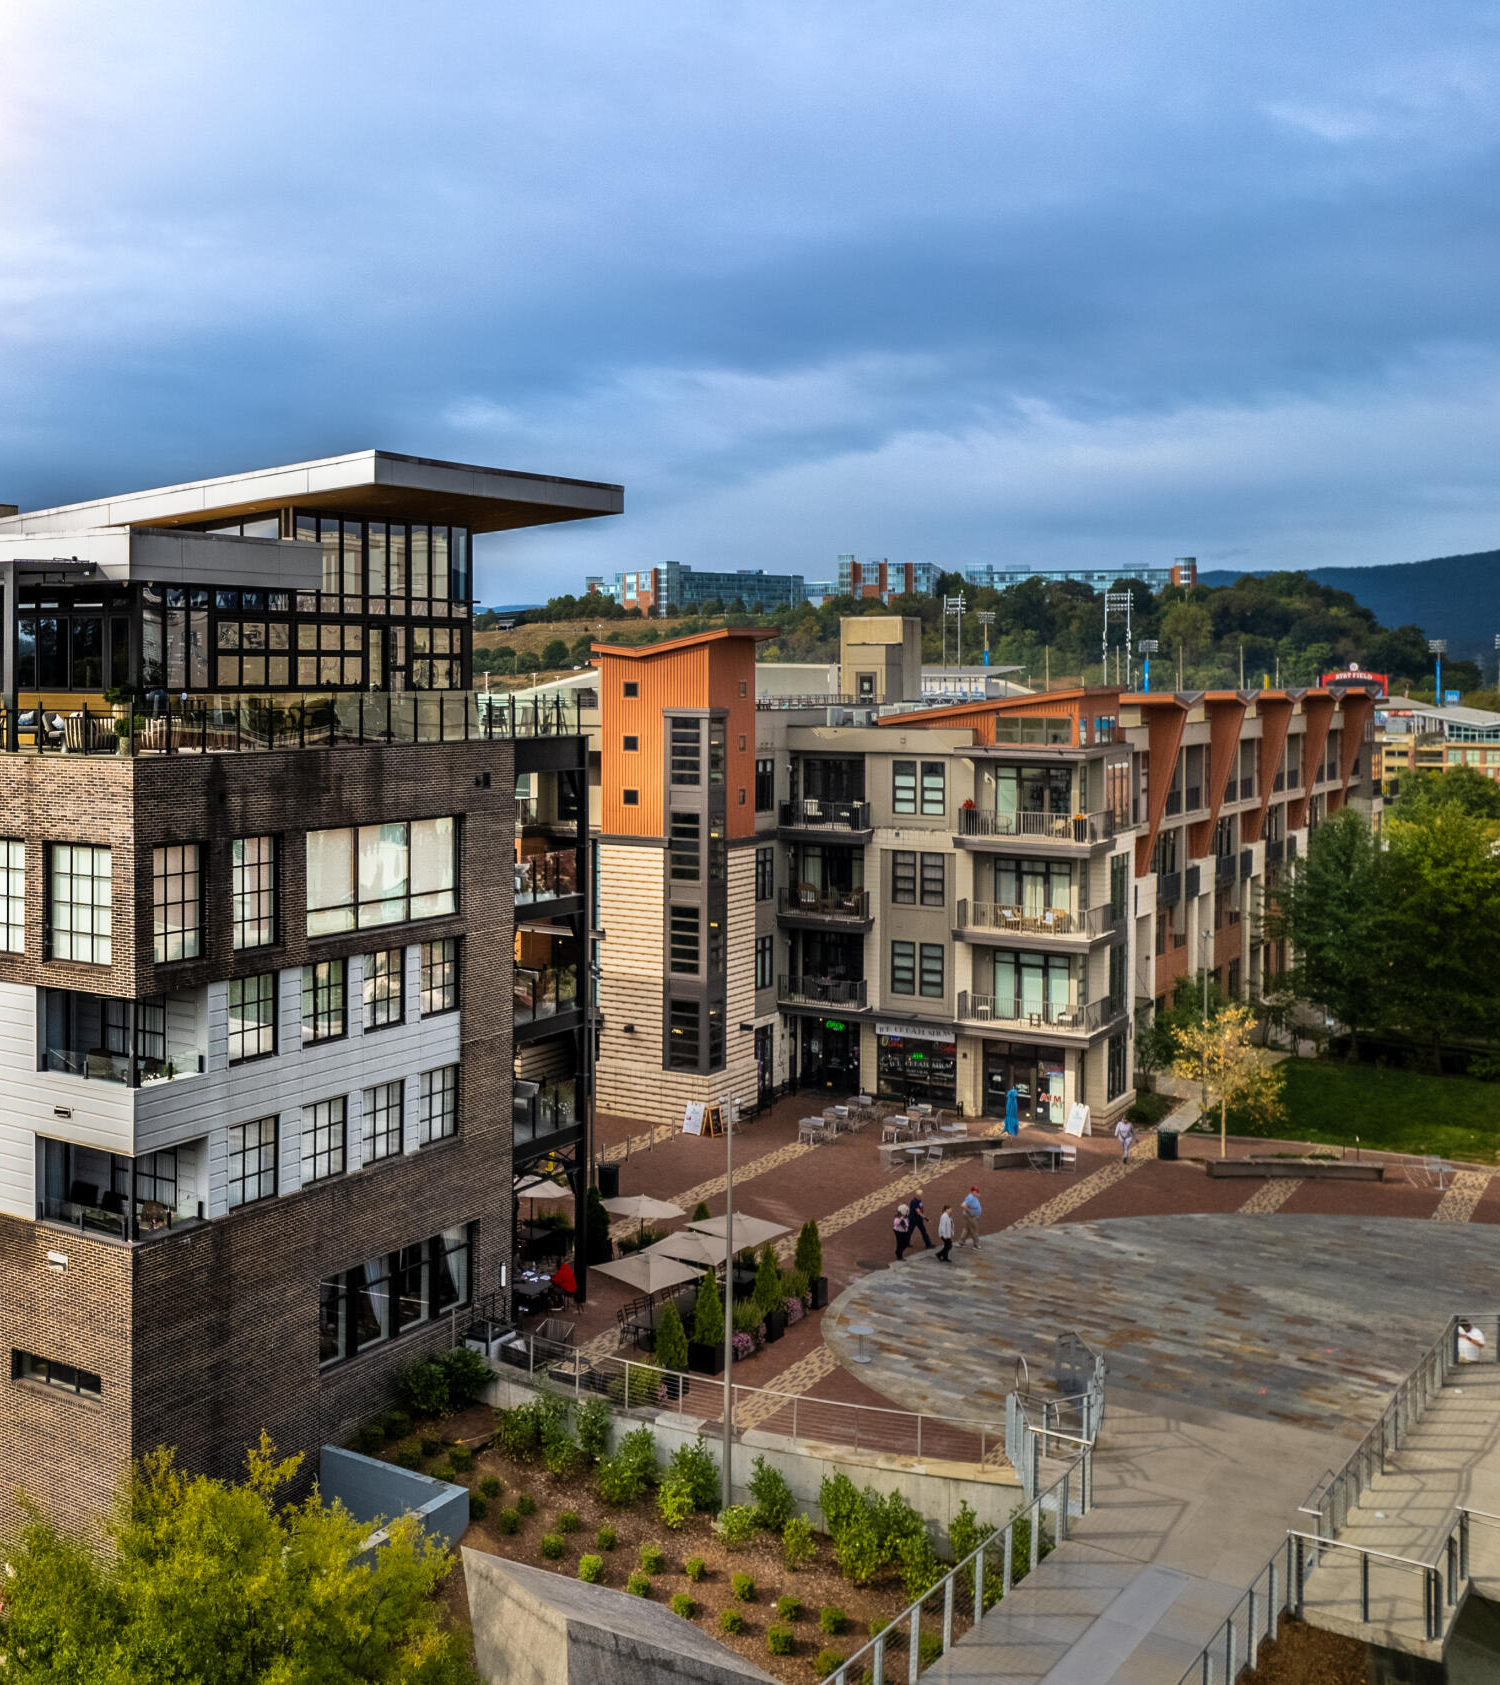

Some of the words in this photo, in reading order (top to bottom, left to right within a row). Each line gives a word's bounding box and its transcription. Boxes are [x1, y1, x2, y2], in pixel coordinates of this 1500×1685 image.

[1352, 672, 1373, 680] FIELD
[825, 1020, 845, 1031] OPEN
[1039, 1092, 1062, 1103] ATM
